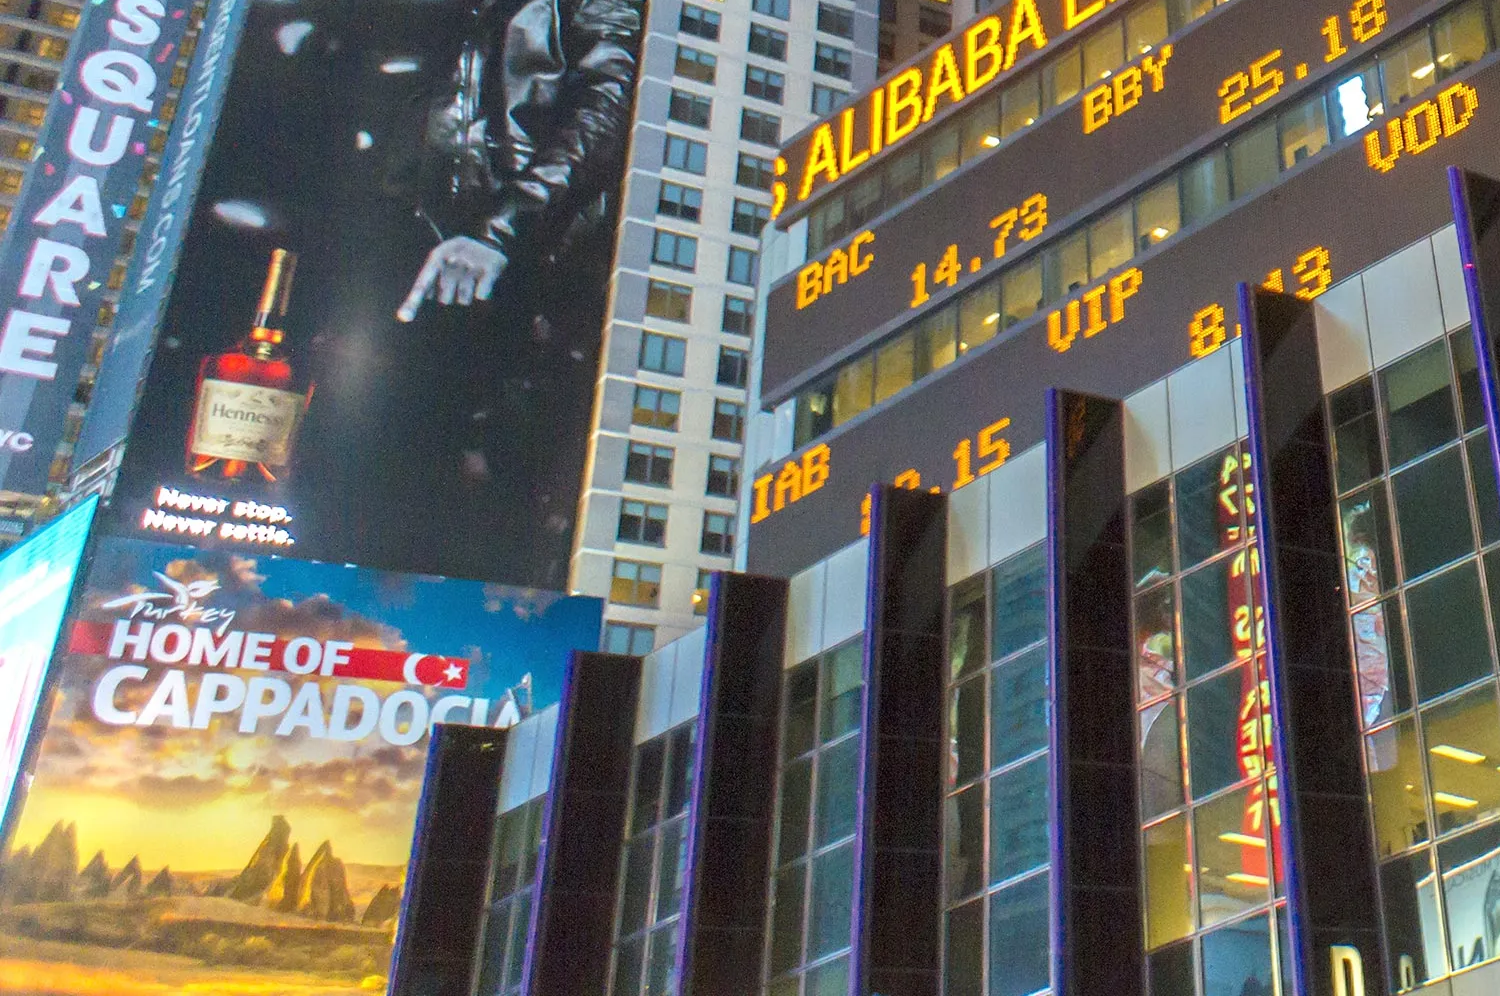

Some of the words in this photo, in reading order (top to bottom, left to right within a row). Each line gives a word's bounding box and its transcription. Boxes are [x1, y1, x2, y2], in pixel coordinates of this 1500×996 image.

[795, 230, 875, 310] BAC
[910, 192, 1049, 309] 14.73
[1082, 44, 1173, 134] BBY
[750, 442, 831, 525] IAB
[1047, 266, 1143, 353] VIP
[1364, 81, 1480, 173] VOD
[140, 508, 217, 538] Never
[219, 522, 295, 546] settle.
[156, 485, 230, 516] Never
[232, 500, 293, 525] stop.
[103, 591, 236, 637] Turkey
[108, 617, 277, 671] HOME
[284, 636, 354, 677] OF
